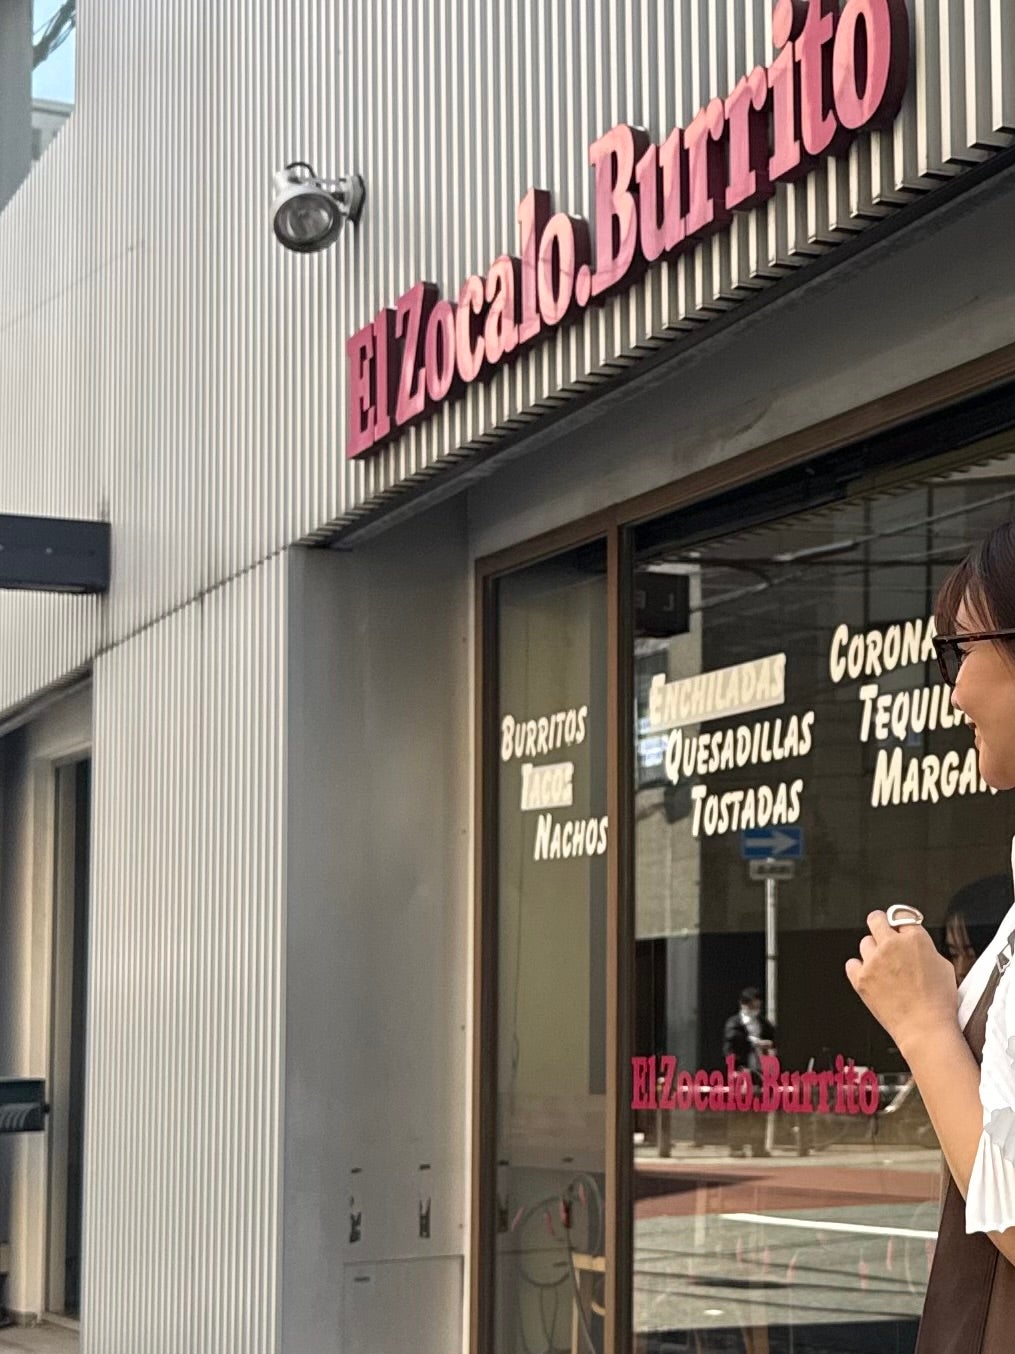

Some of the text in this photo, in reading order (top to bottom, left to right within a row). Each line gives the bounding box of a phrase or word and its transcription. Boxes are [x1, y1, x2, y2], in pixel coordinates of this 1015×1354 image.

[346, 307, 391, 459] El
[829, 615, 938, 683] CORONA
[501, 705, 588, 762] BURRITOS
[664, 711, 815, 784] QUESADILLAS
[871, 747, 998, 808] MARGA
[534, 813, 608, 861] NACHOS
[691, 779, 804, 837] TOSTADAS
[631, 1055, 656, 1110] El
